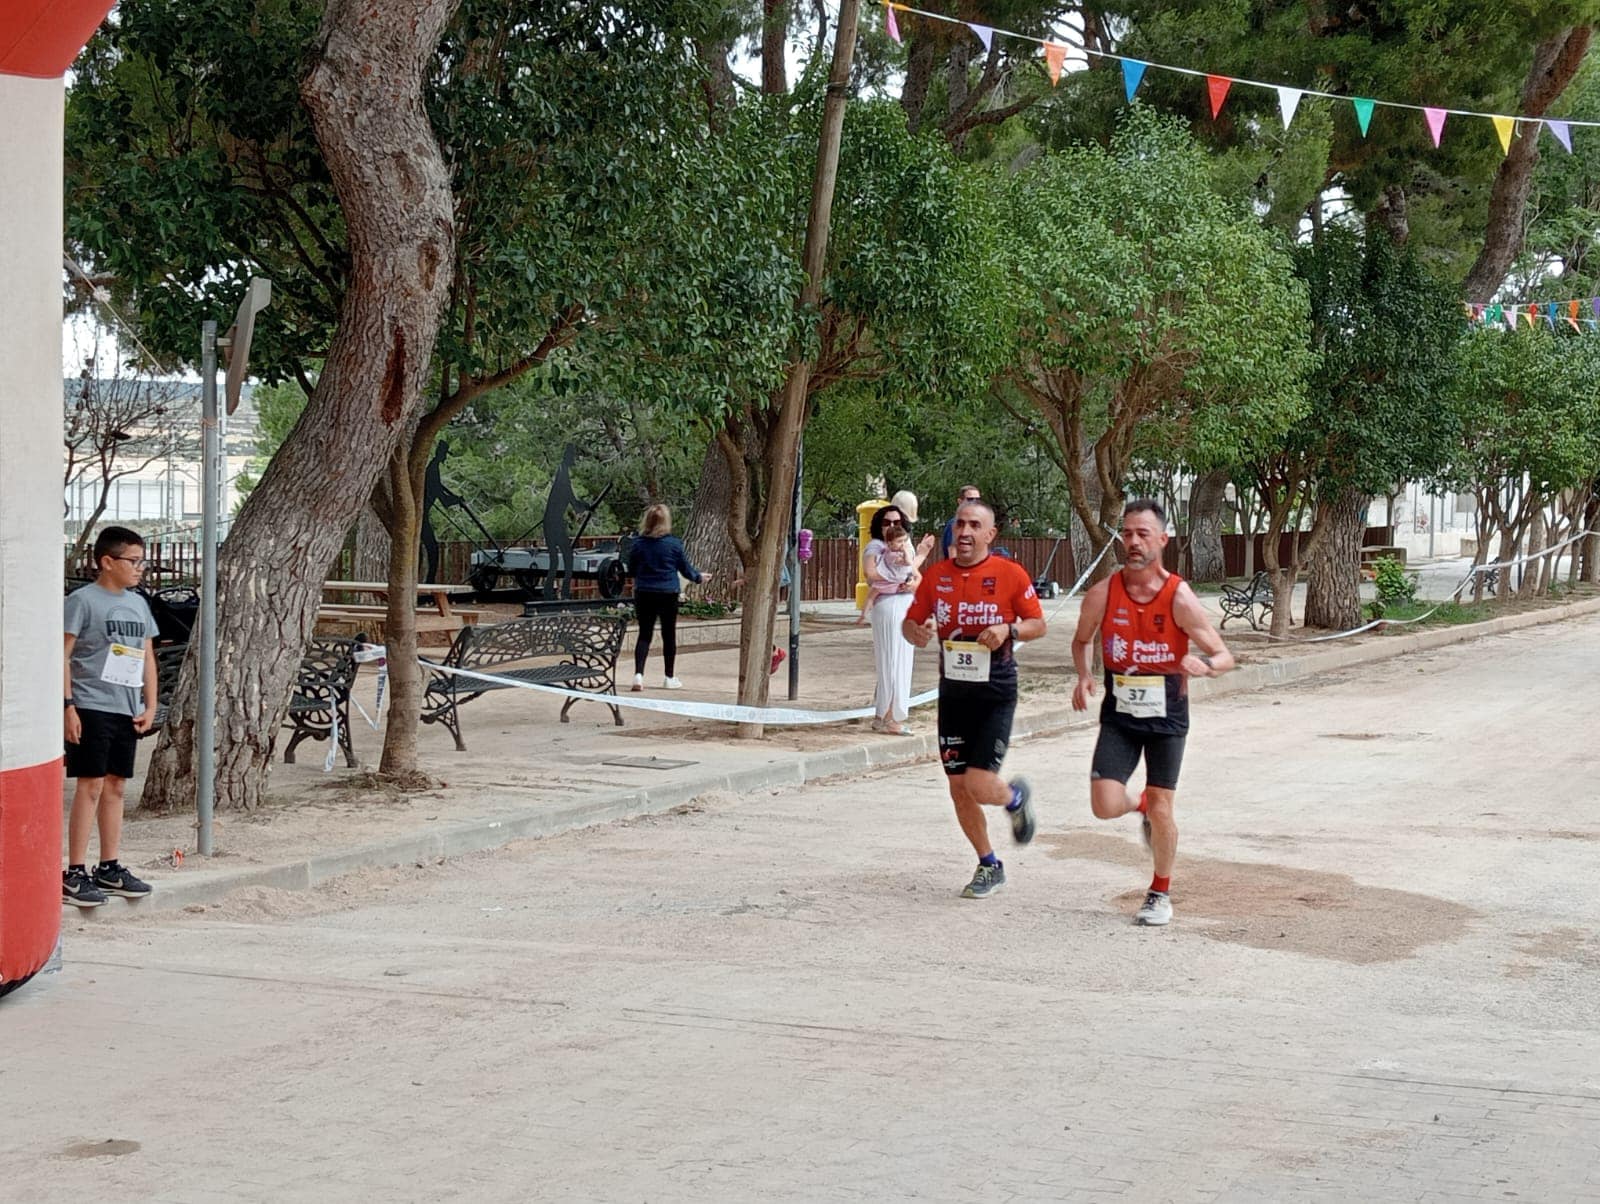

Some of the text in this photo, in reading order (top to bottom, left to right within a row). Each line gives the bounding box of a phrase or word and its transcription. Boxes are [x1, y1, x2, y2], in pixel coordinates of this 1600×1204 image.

[958, 601, 998, 613] Pedro
[957, 613, 1004, 625] Cerdán
[1133, 640, 1169, 652] Pedro
[957, 653, 973, 665] 38
[1132, 651, 1175, 664] Cerdán
[1128, 688, 1147, 701] 37
